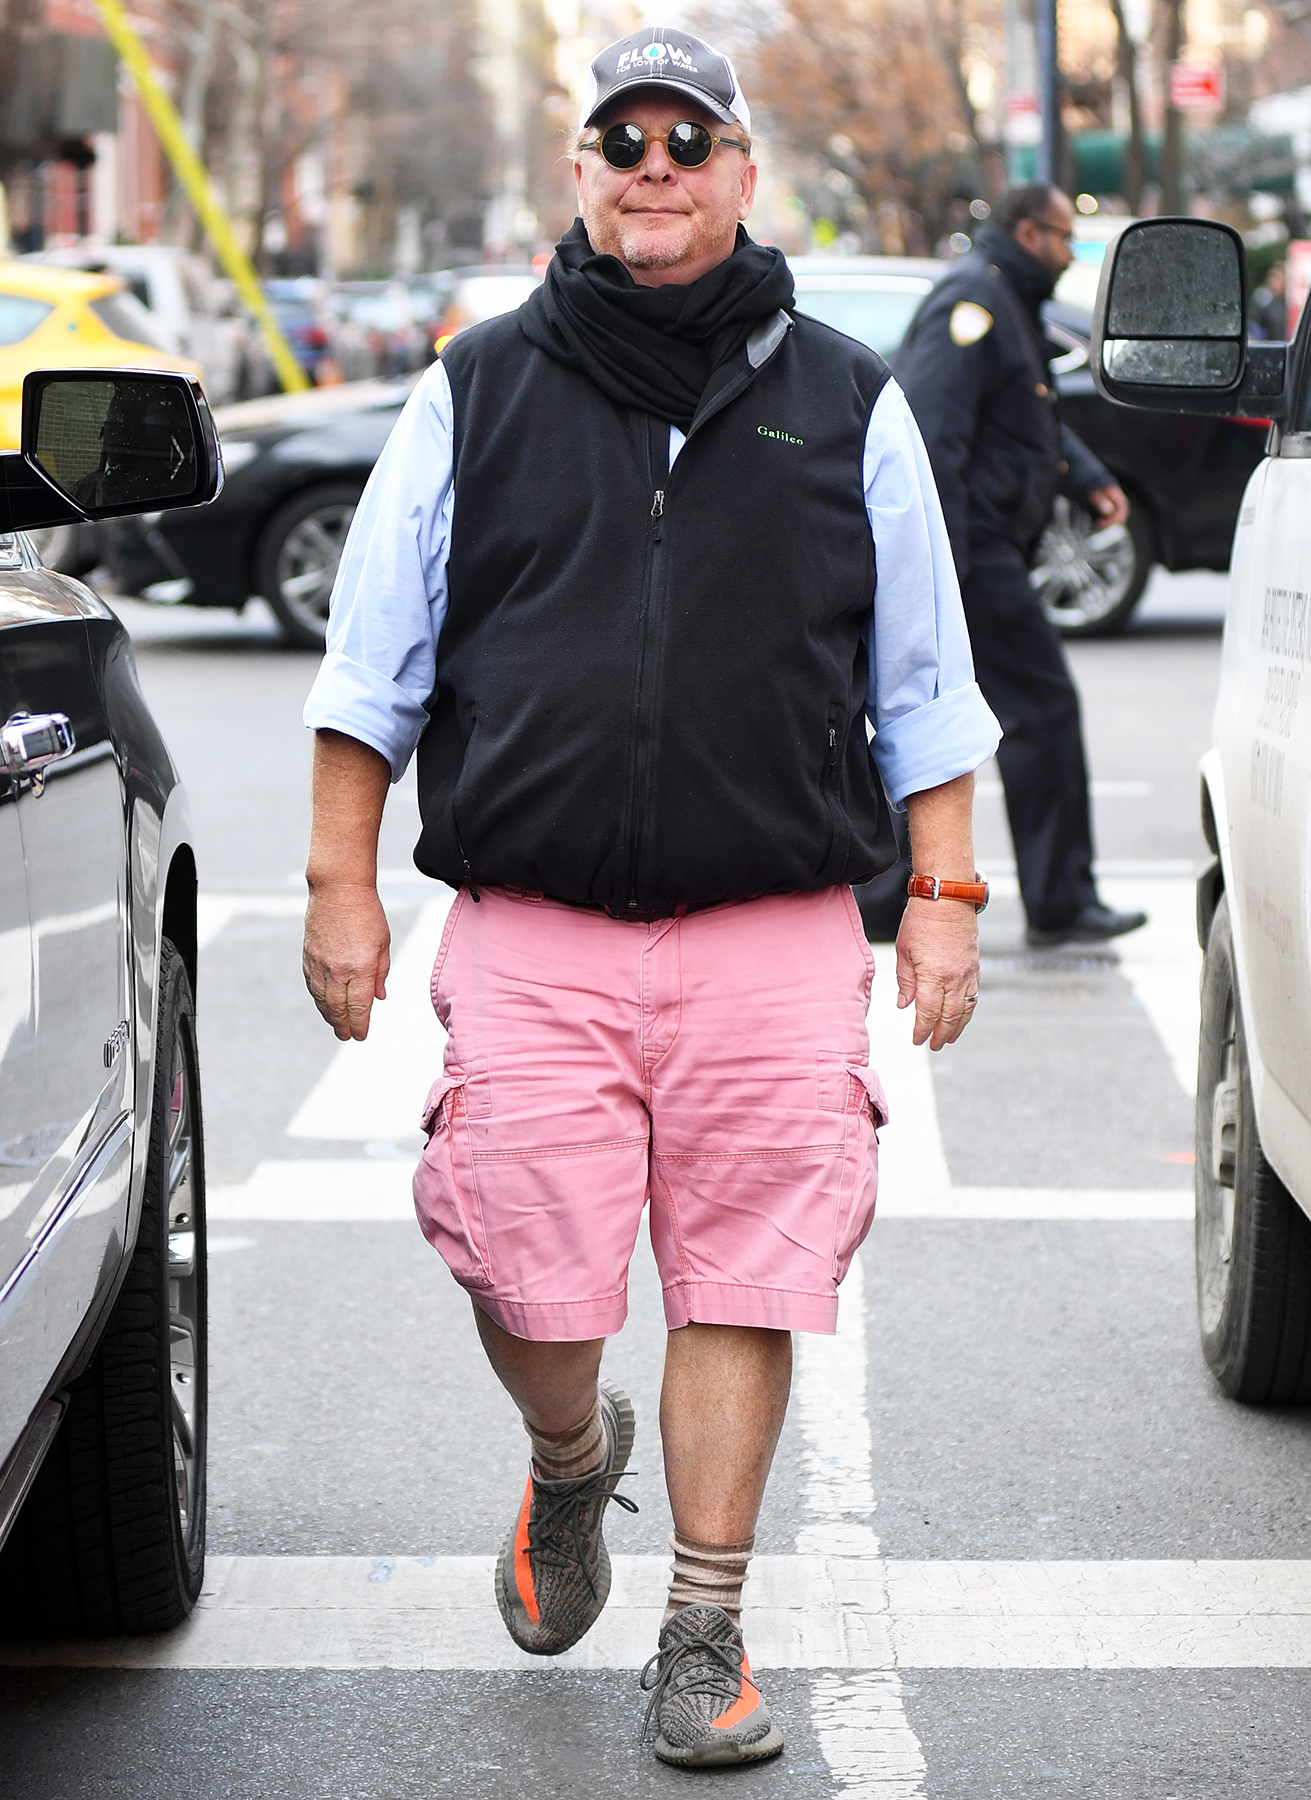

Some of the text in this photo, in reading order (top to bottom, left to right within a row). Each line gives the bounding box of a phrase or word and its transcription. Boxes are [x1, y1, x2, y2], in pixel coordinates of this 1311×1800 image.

[617, 42, 693, 68] FLOW
[616, 64, 631, 74] FOR
[672, 60, 698, 73] WATER
[757, 425, 804, 446] Galileo
